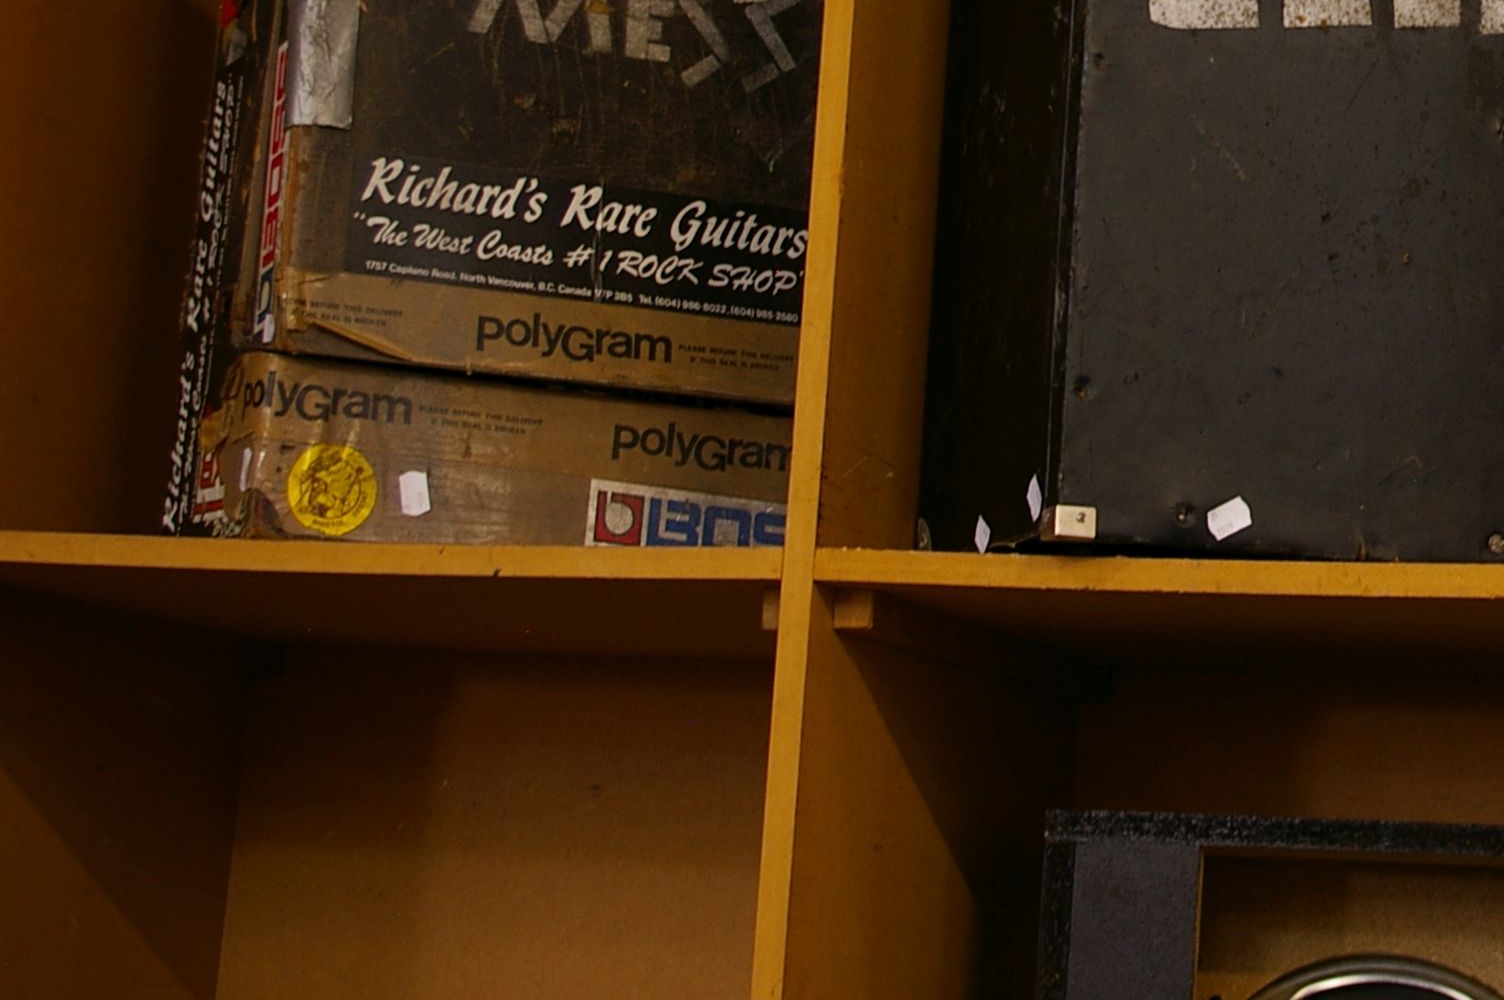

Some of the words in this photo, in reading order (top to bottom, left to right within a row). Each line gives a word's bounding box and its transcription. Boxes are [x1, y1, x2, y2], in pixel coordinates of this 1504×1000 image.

[186, 238, 209, 334] Rare
[200, 80, 226, 223] Guitars
[361, 156, 549, 224] Richard's
[560, 183, 658, 239] Rare
[670, 199, 809, 260] Guitars
[412, 222, 474, 256] West
[476, 229, 554, 266] Coasts
[616, 250, 704, 286] ROCK
[459, 271, 486, 284] North
[557, 283, 592, 298] Canada
[475, 311, 673, 364] polyGram
[241, 370, 413, 426] polyGram
